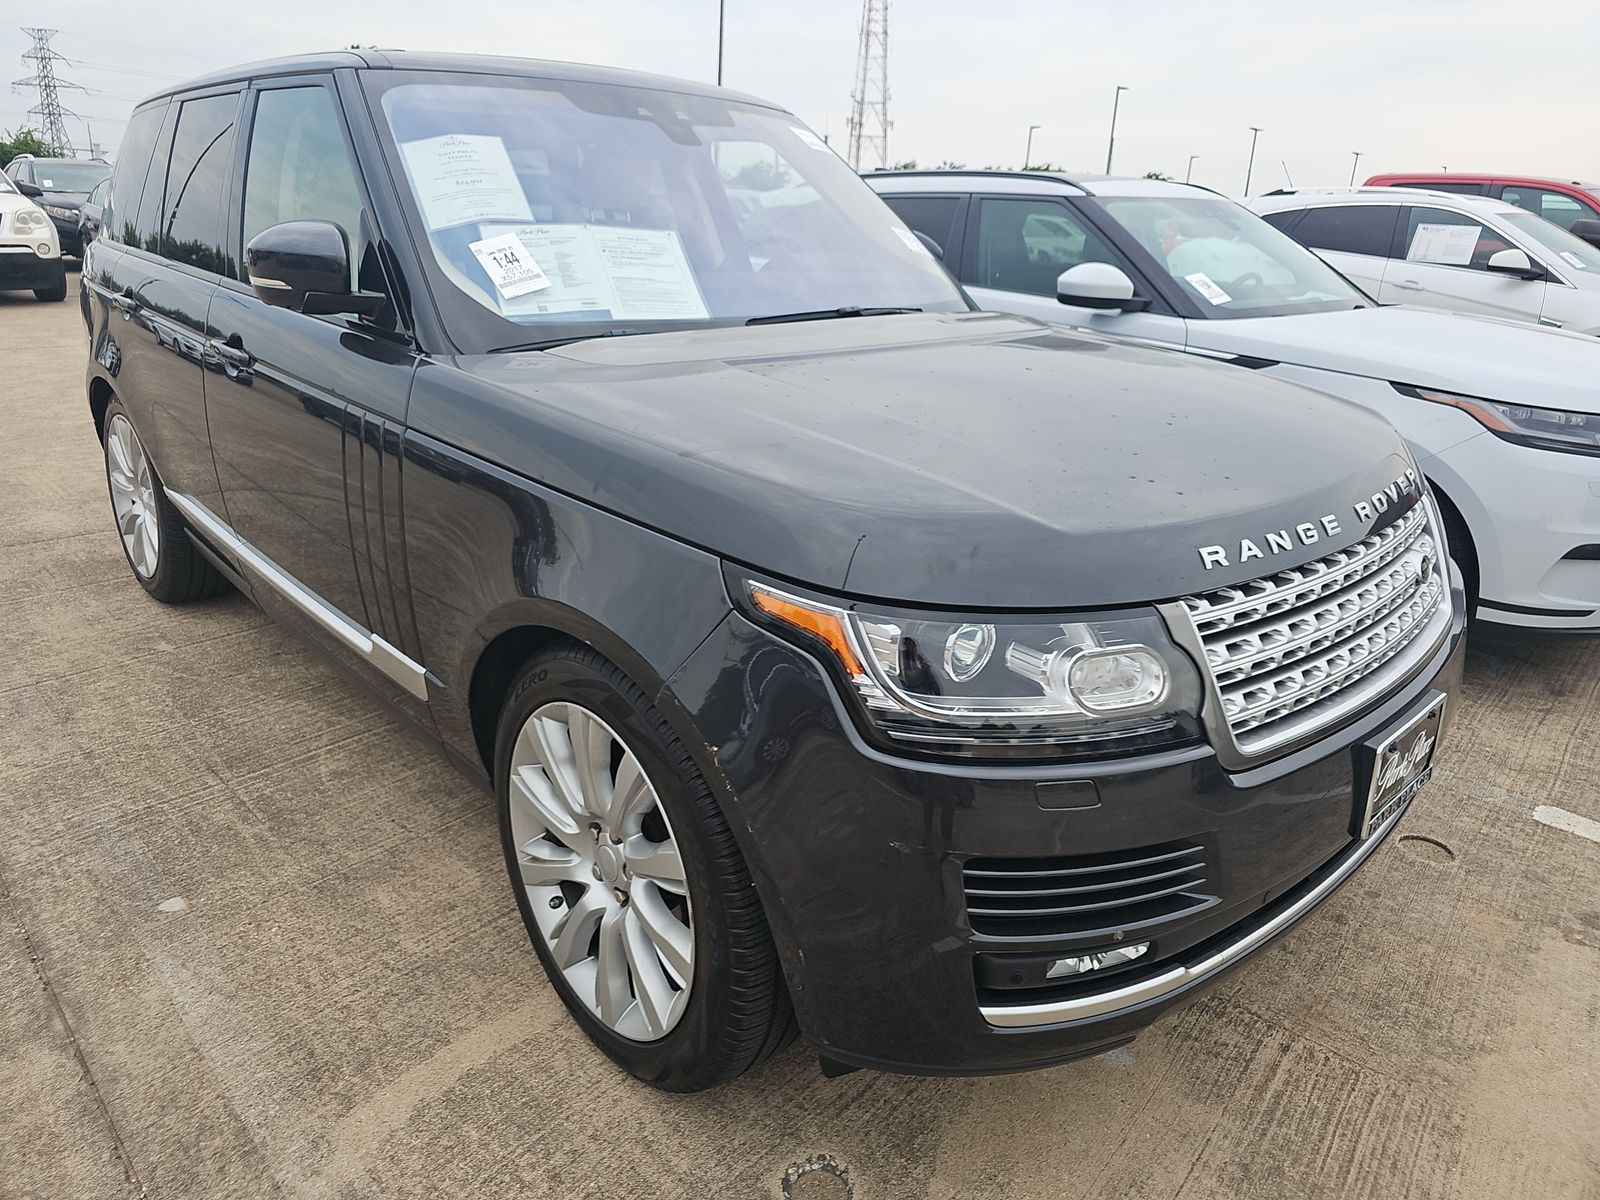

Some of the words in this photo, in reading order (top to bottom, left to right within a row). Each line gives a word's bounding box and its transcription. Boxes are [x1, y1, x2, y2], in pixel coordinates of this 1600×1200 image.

[492, 251, 520, 269] 1:44
[1198, 513, 1342, 570] RANGE
[1353, 467, 1417, 523] ROVER
